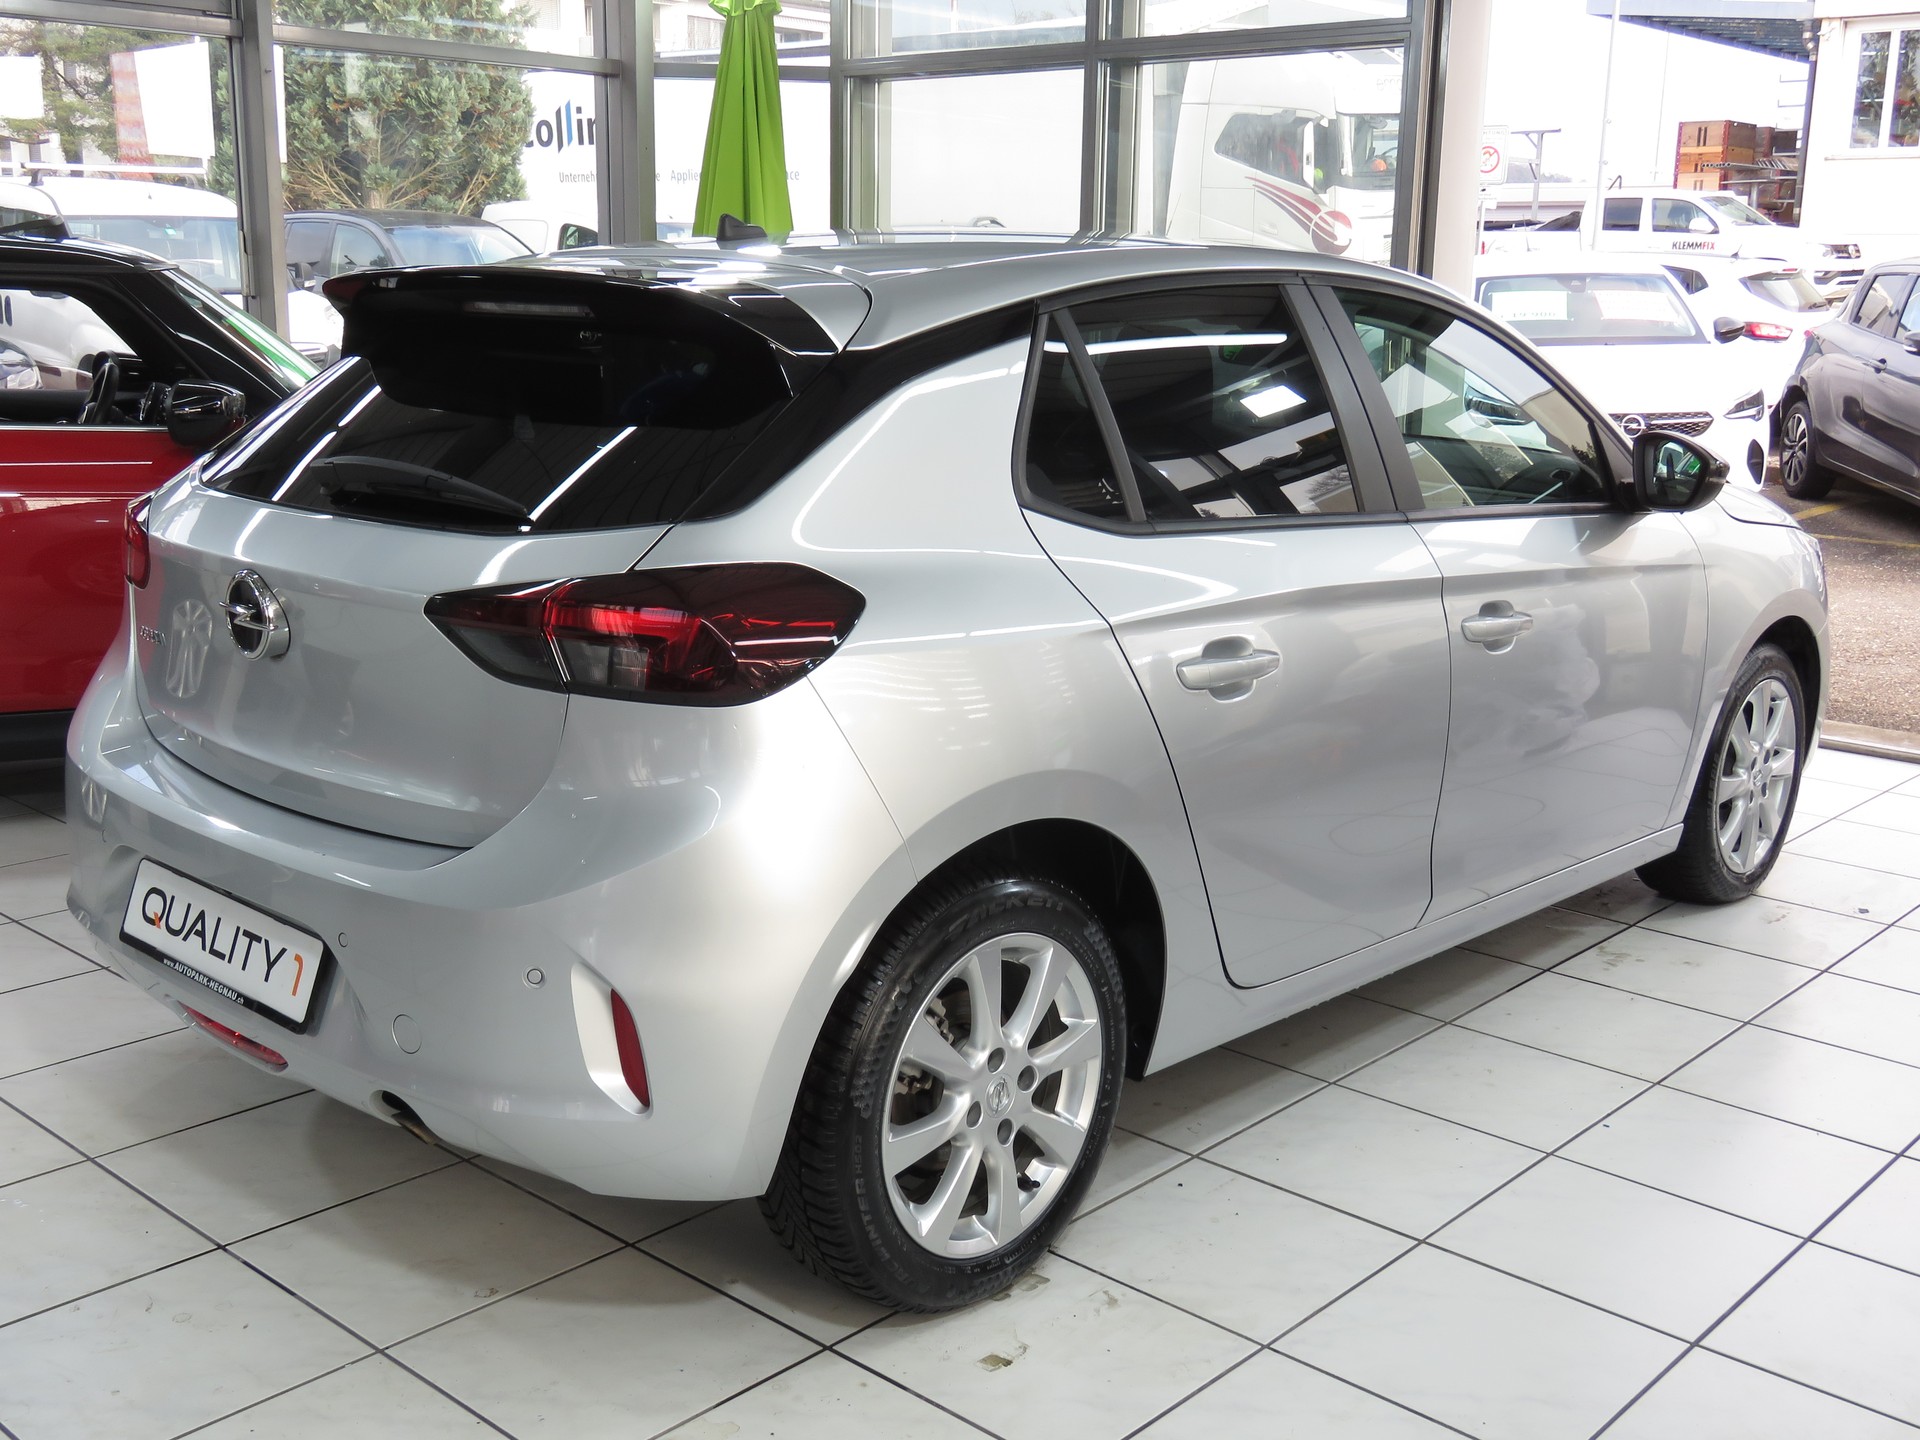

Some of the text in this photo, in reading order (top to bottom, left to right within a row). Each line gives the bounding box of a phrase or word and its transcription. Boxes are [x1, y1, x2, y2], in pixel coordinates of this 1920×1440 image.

[558, 171, 598, 184] Unterneh
[1672, 241, 1715, 250] KLEMMFIX
[163, 958, 245, 1005] www.AUTOPARK-HEGNAU.ch
